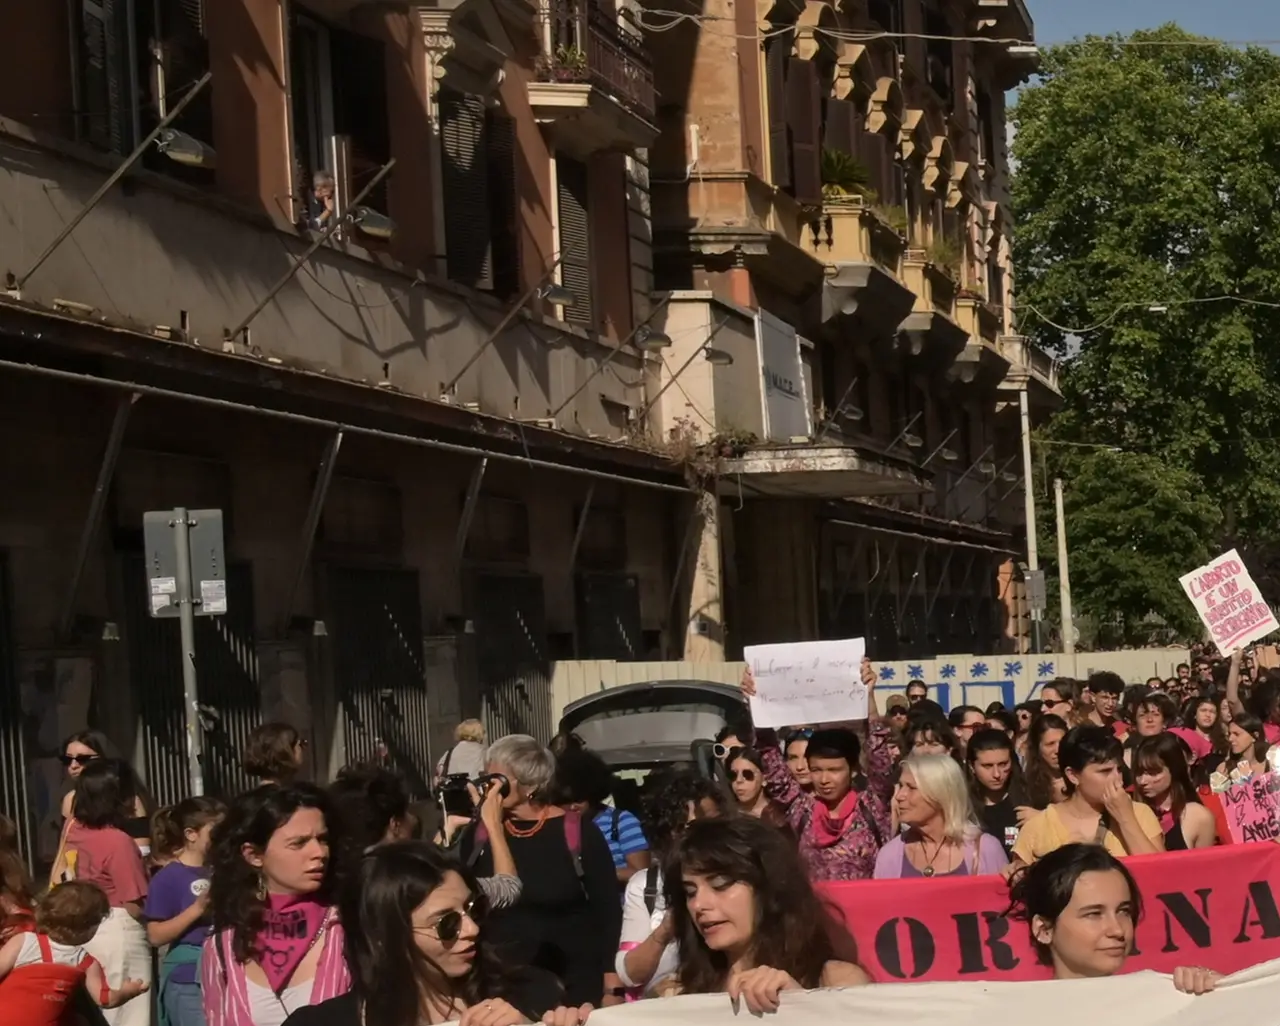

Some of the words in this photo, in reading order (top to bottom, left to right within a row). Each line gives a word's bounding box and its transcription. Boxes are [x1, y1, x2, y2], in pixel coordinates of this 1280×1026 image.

[1189, 560, 1241, 599] L'ABORTO
[1219, 578, 1239, 598] UN
[1224, 785, 1251, 807] NON
